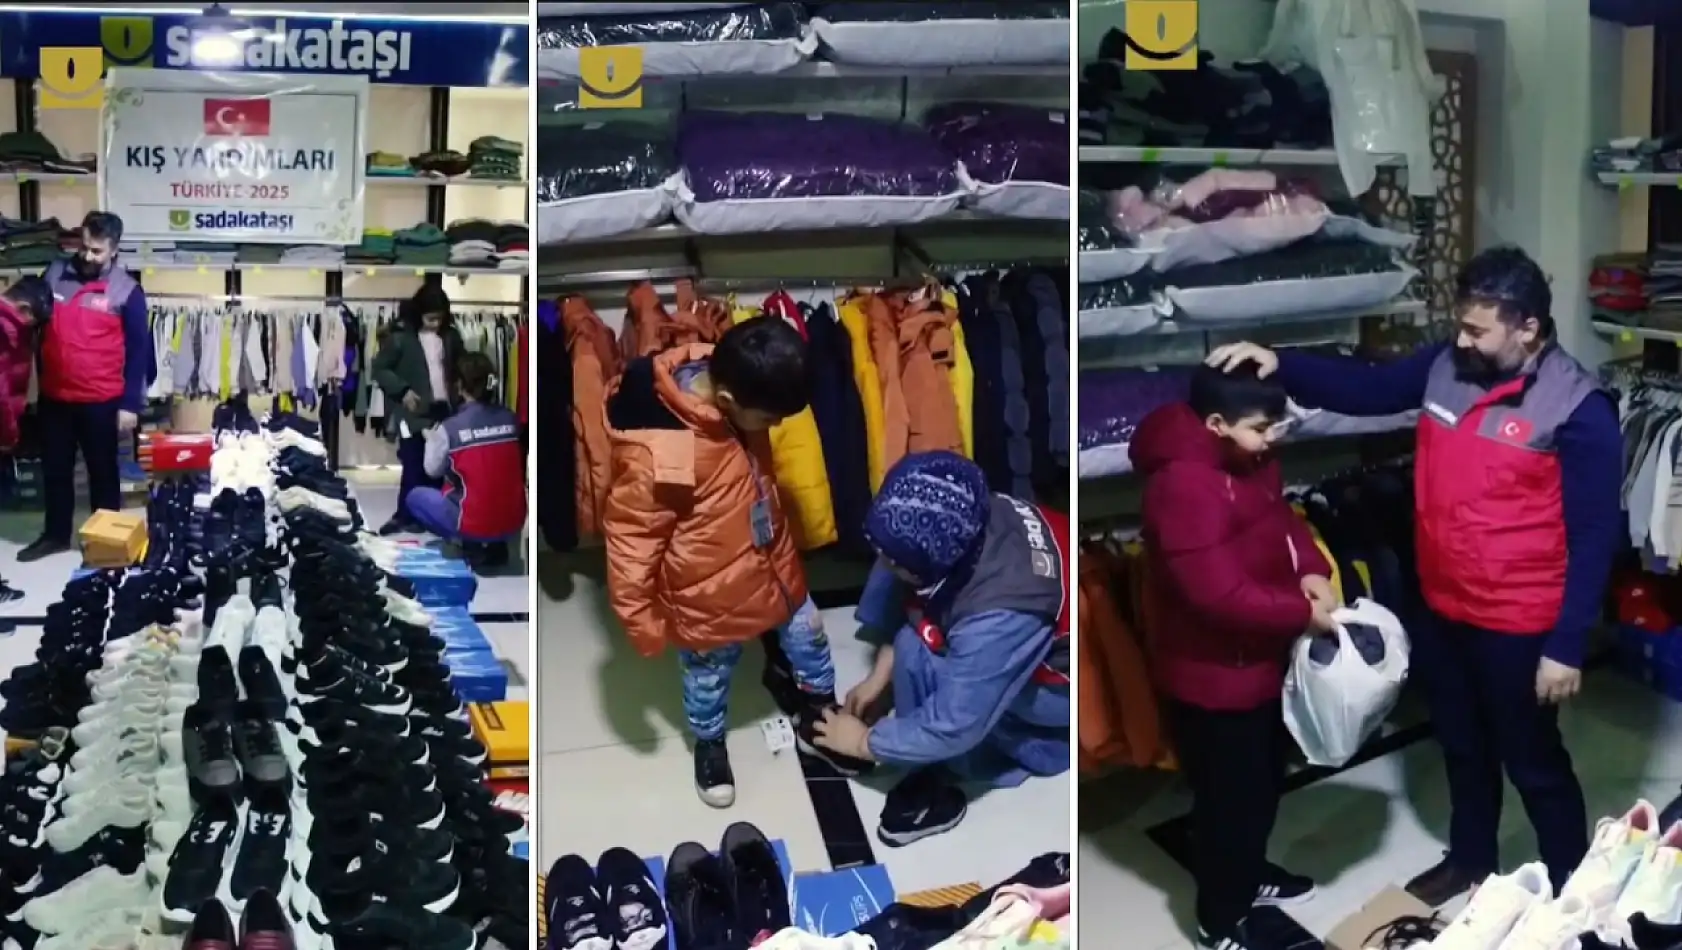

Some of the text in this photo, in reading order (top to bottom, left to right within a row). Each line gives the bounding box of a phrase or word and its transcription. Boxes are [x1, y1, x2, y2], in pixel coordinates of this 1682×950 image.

[166, 19, 411, 78] sakataşı
[127, 146, 335, 173] KIŞ YADMLARI
[195, 210, 293, 233] sadakataşı
